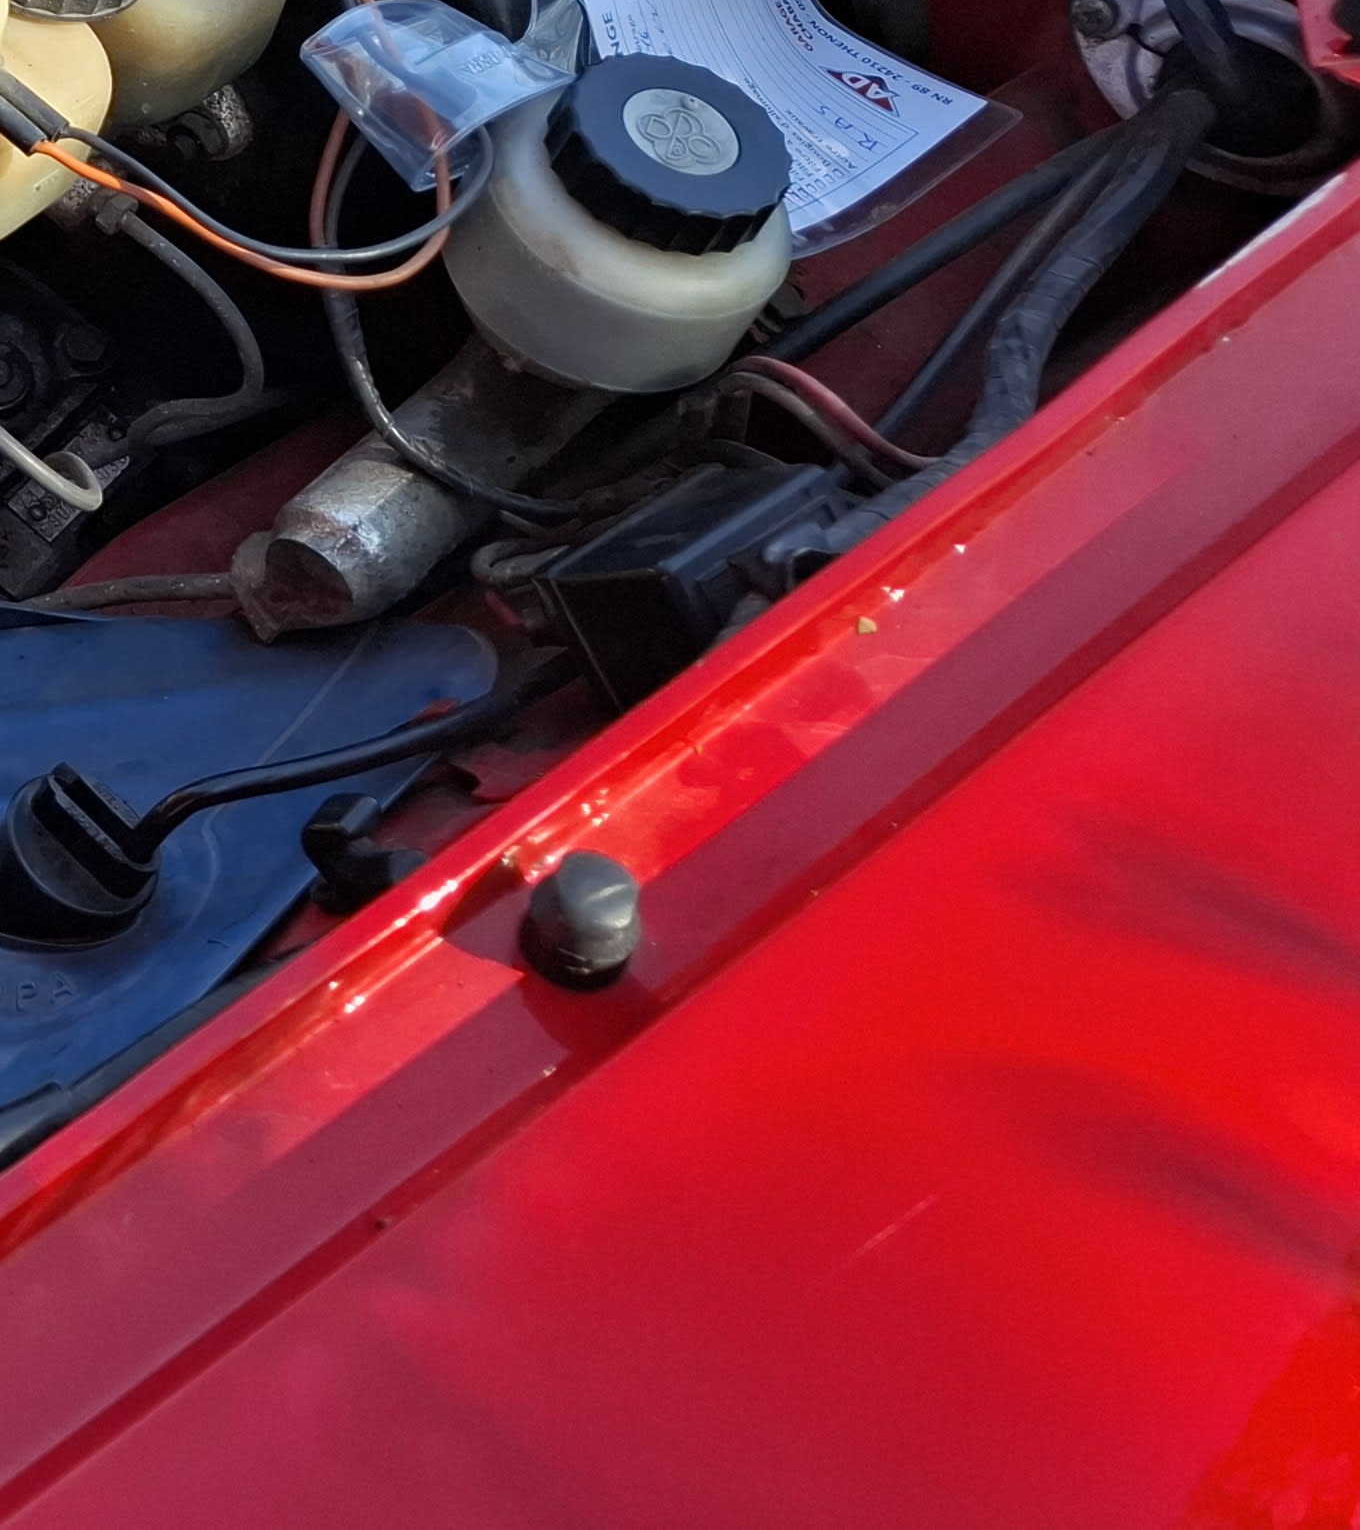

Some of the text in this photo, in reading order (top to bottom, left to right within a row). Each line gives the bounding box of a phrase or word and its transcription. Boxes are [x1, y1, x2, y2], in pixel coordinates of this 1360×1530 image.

[809, 9, 857, 57] THENON
[861, 57, 902, 80] 24210
[838, 72, 892, 106] AD
[911, 83, 930, 94] 89
[932, 92, 953, 105] RN
[781, 109, 857, 169] Autre travaux
[791, 131, 834, 167] Bougies
